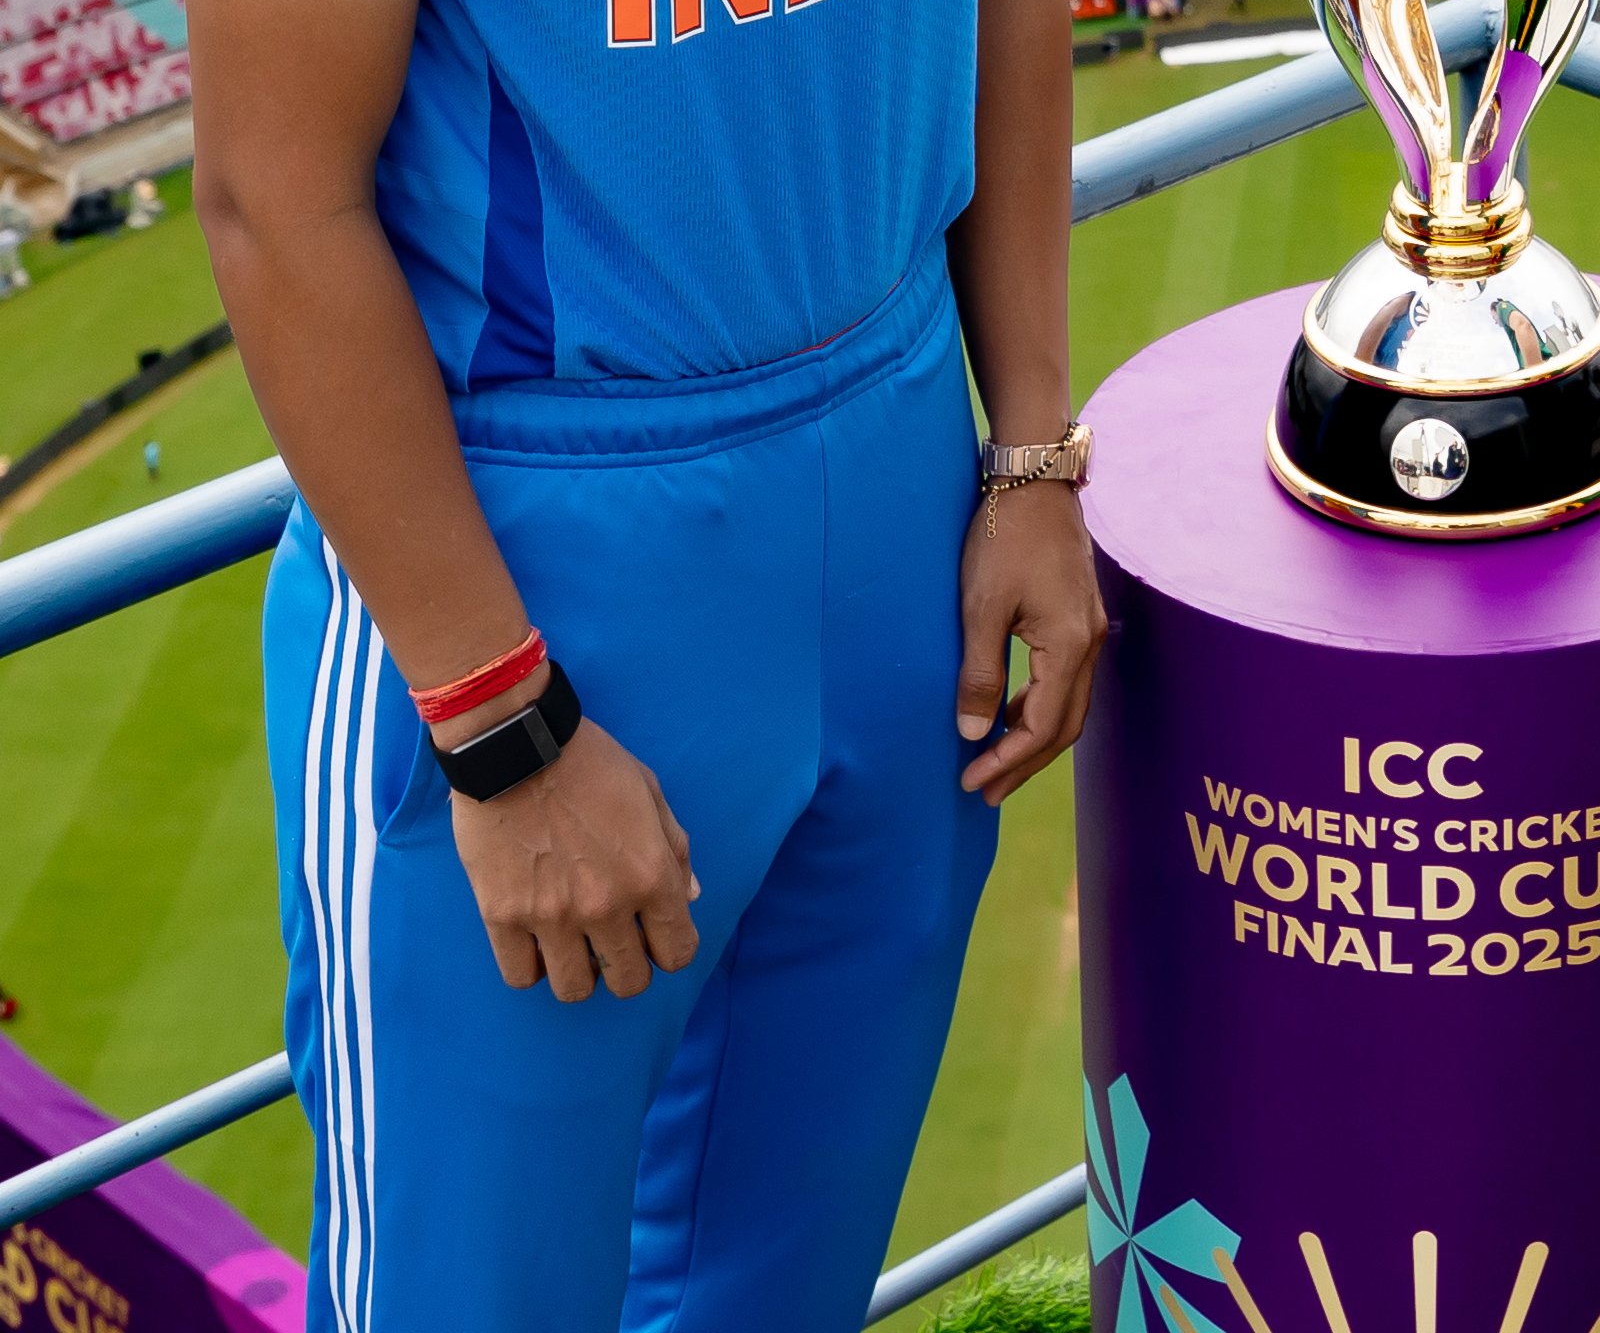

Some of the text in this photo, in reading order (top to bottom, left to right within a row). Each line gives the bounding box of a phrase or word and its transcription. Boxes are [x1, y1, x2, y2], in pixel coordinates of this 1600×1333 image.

[1344, 736, 1484, 799] ICC
[1204, 775, 1419, 852] WOMEN'S
[1185, 811, 1476, 921] WORLD
[1234, 900, 1413, 974] FINAL
